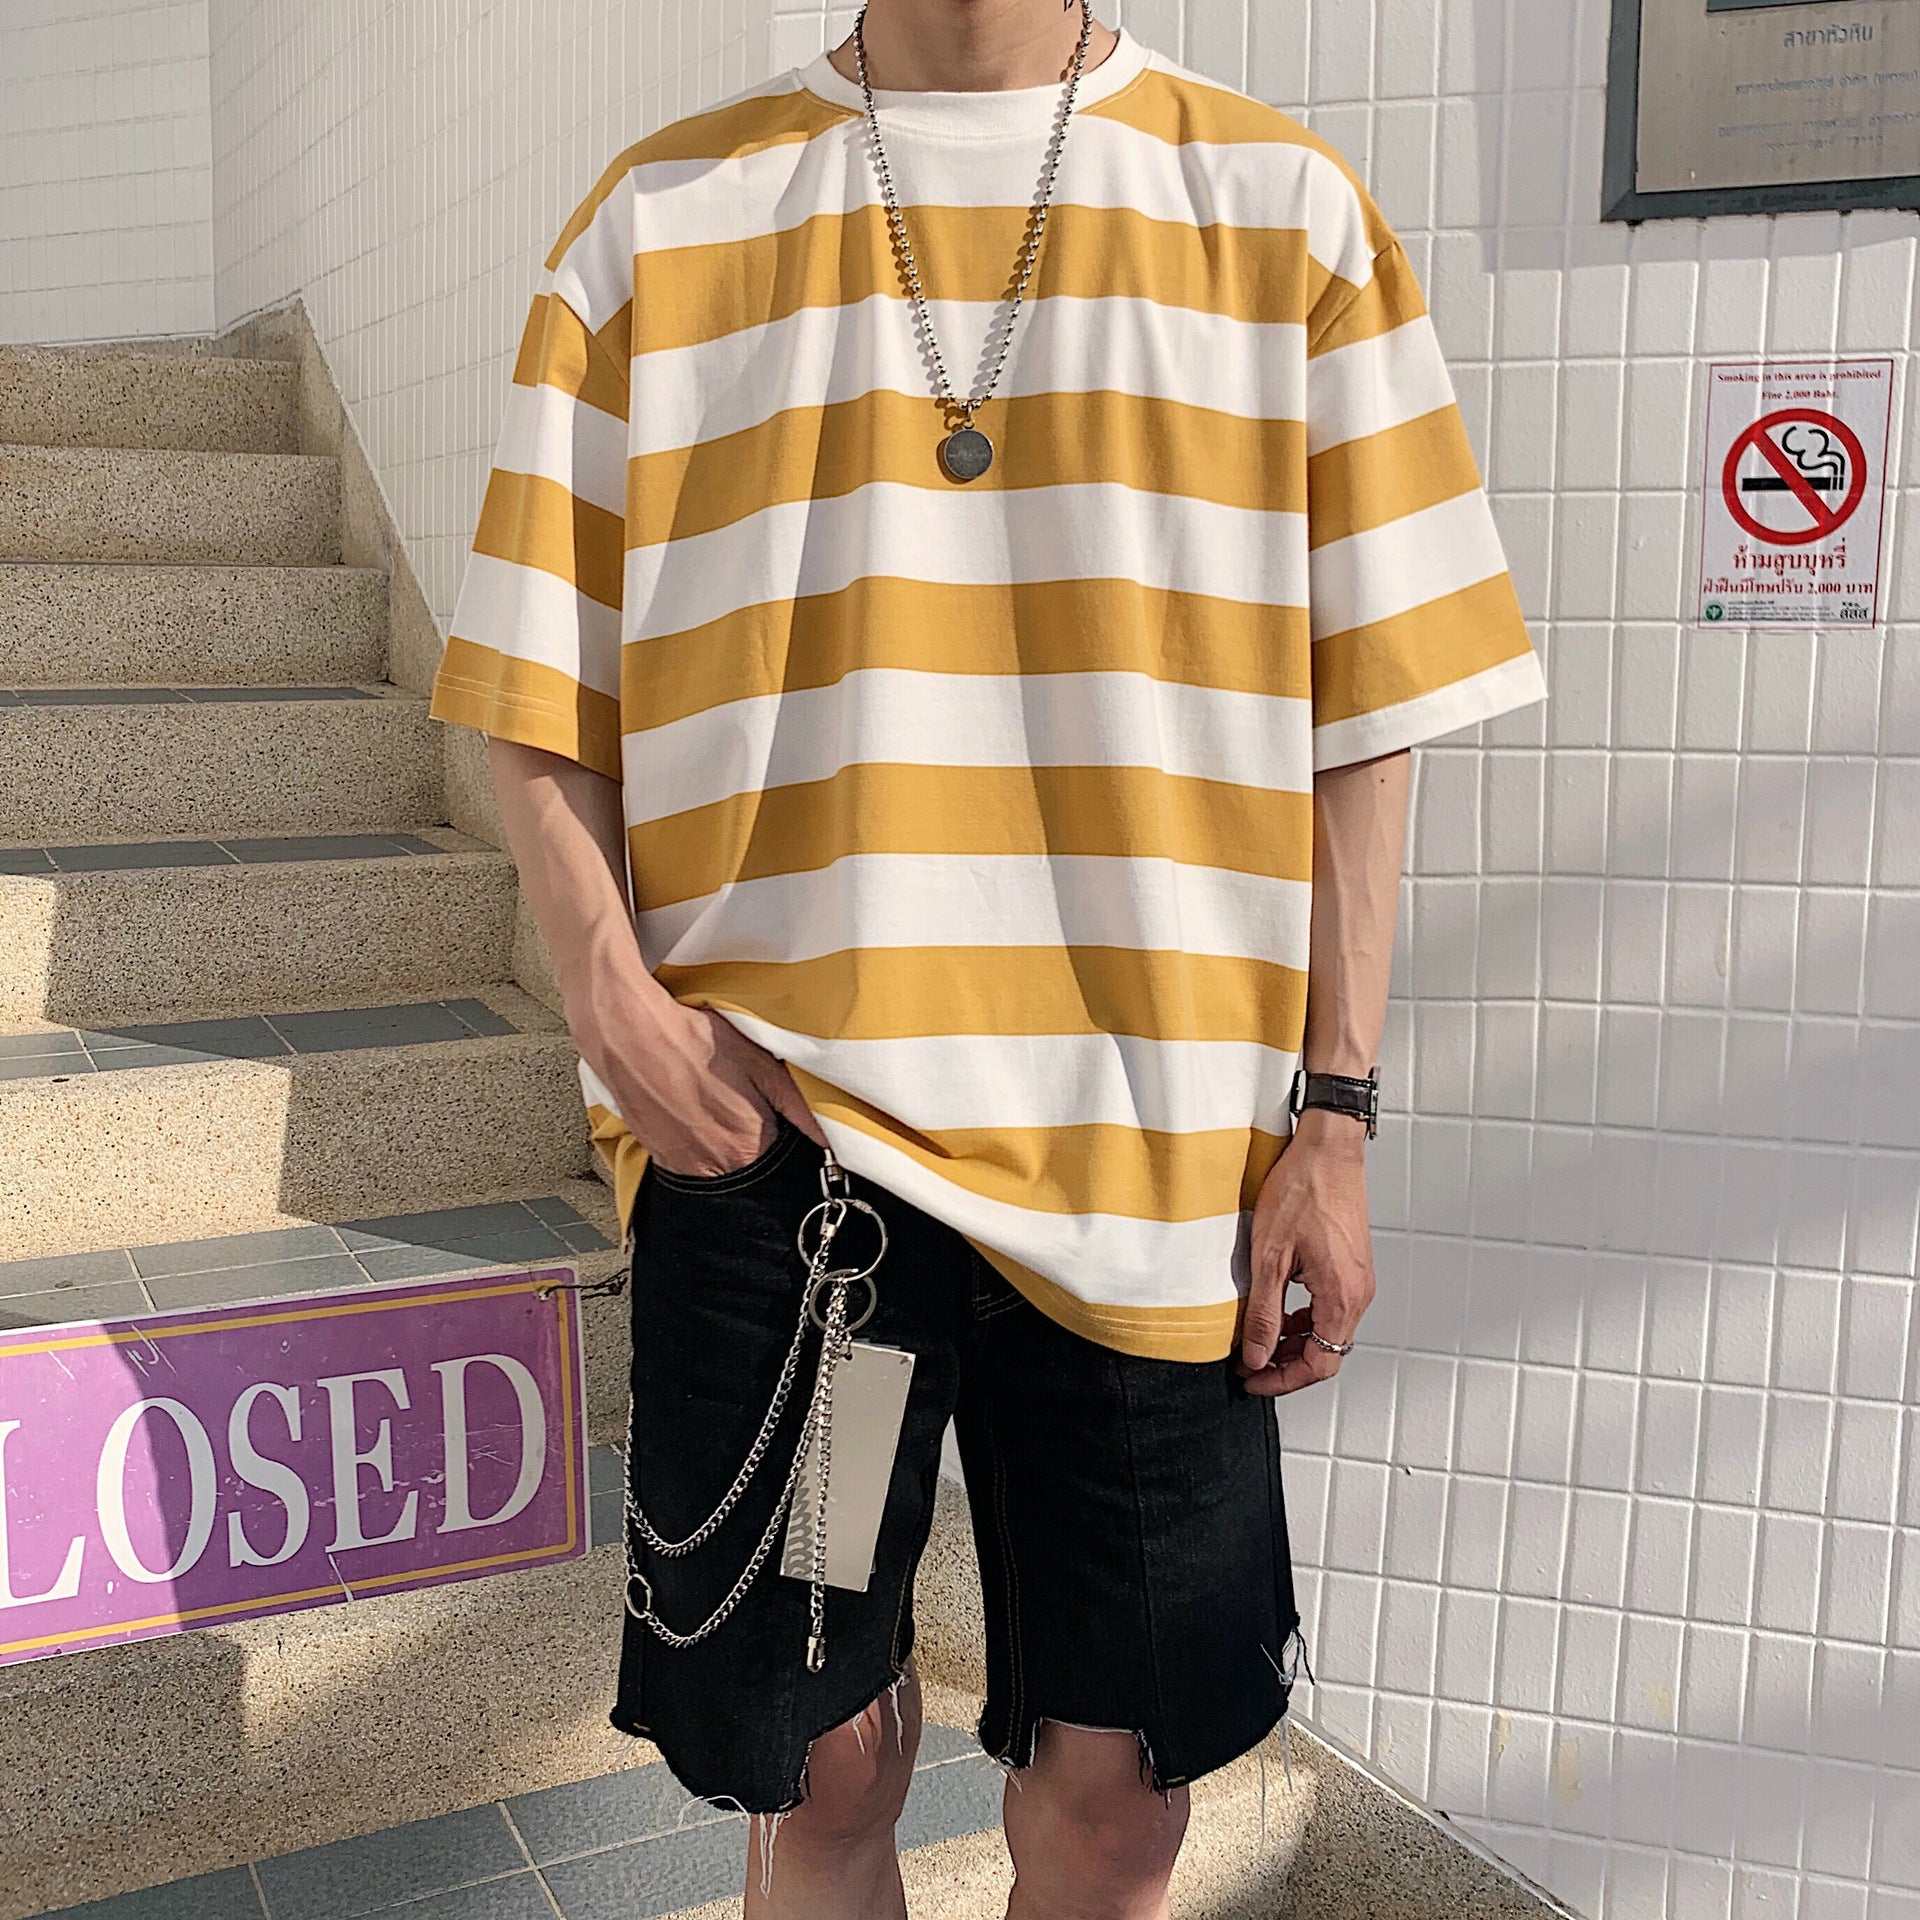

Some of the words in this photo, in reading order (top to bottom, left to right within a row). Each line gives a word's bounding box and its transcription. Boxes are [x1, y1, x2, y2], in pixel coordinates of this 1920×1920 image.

[1717, 373, 1759, 383] Smoking
[1829, 369, 1881, 381] prohibited
[1762, 390, 1783, 400] Fine
[1785, 390, 1811, 400] 2,000
[1733, 537, 1847, 576] ห้ามสูบบุหรี่
[1807, 583, 1841, 595] 2,000
[1846, 583, 1873, 593] บาท
